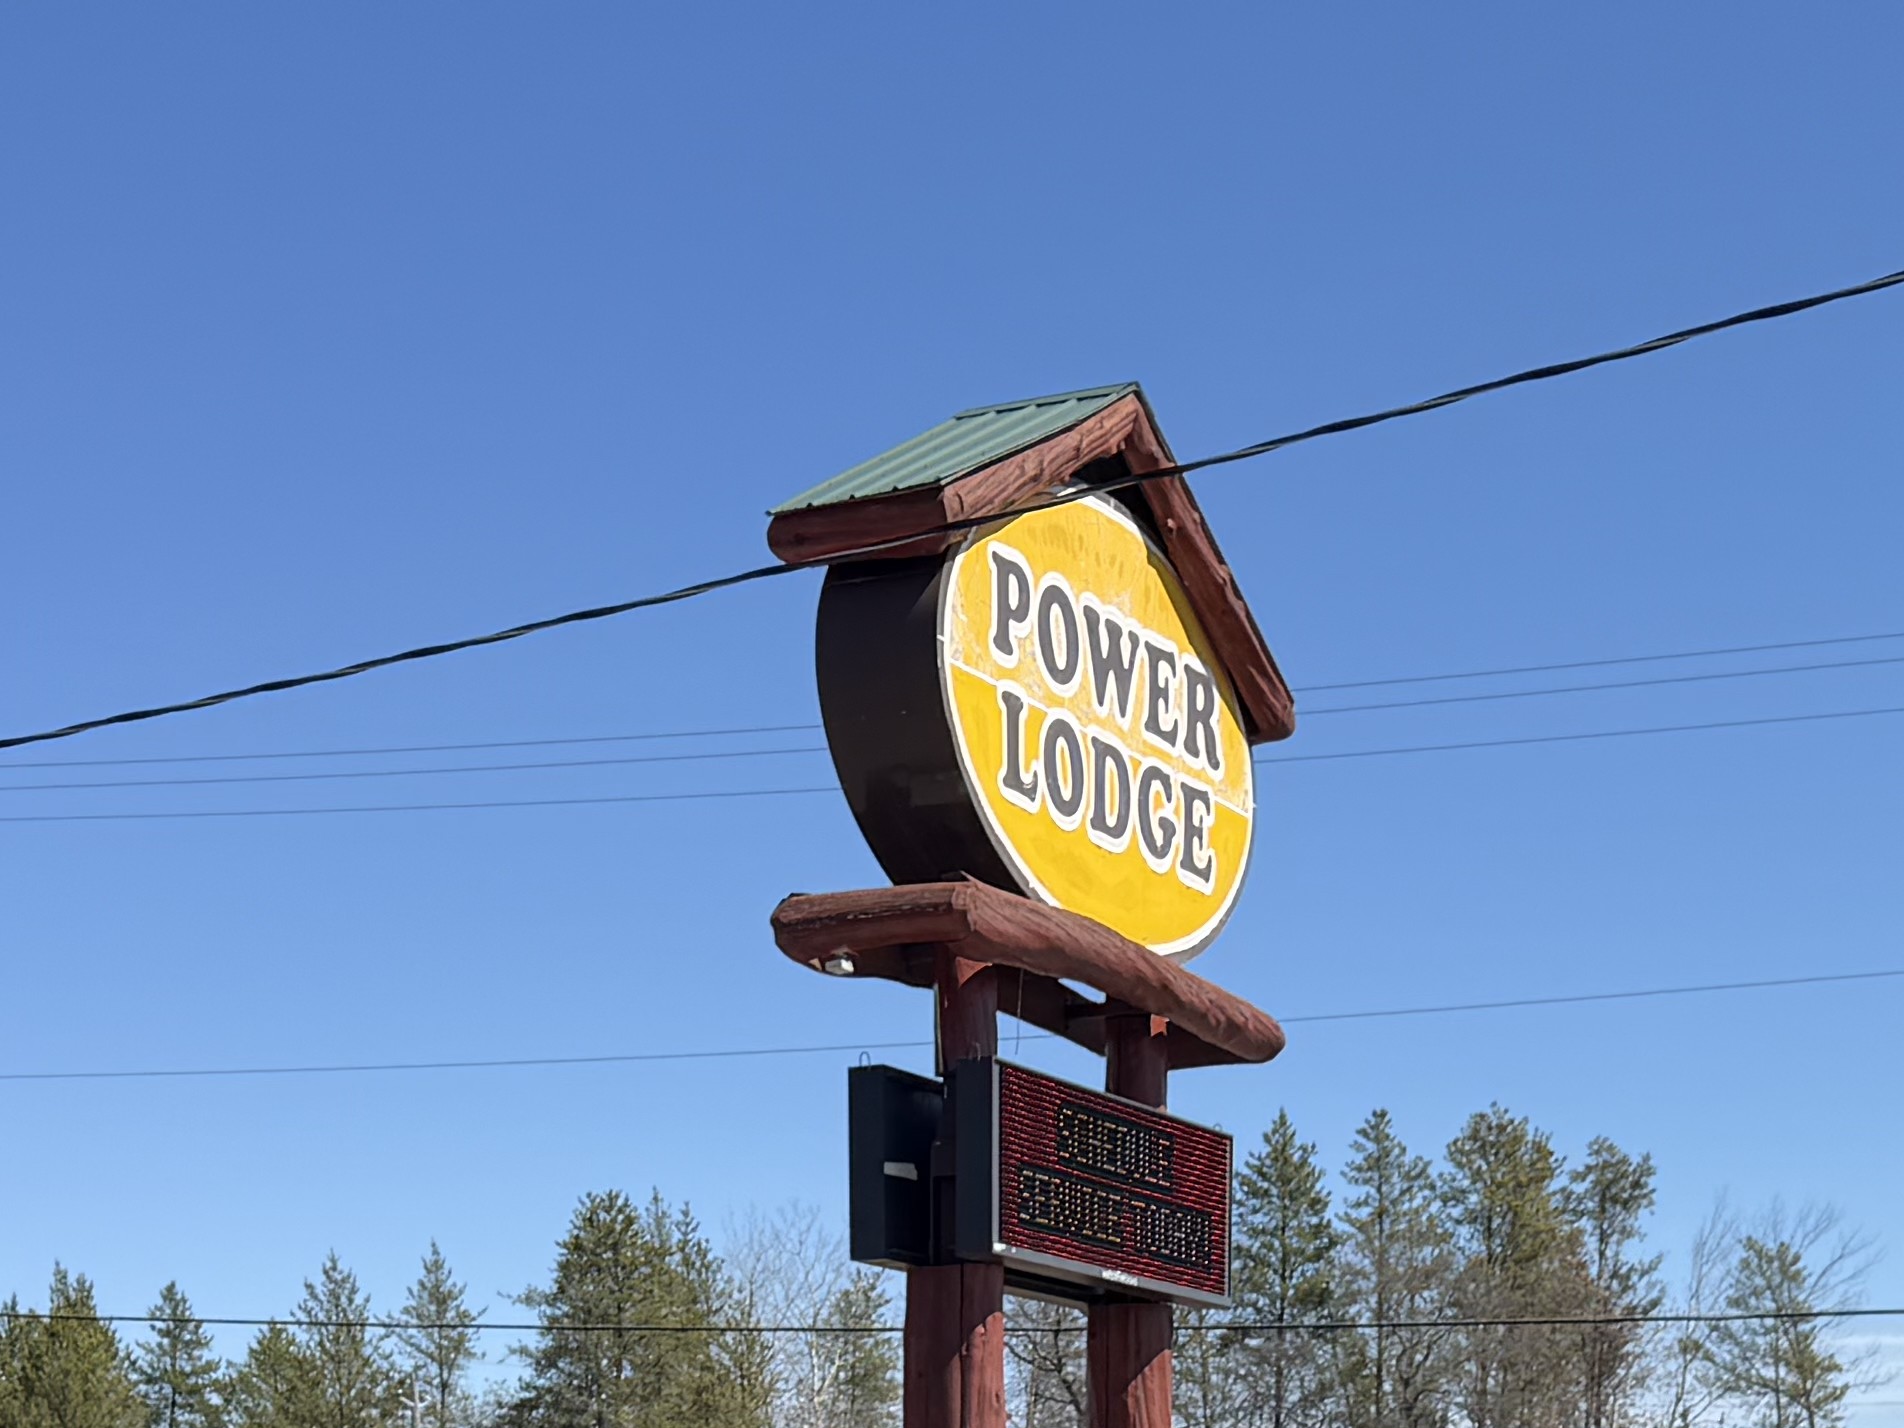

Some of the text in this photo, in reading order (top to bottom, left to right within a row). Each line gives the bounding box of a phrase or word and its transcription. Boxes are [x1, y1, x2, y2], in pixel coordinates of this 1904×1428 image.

[990, 549, 1222, 772] POWER
[999, 689, 1215, 885] LODGE
[1019, 1169, 1122, 1243] SERVICE
[1059, 1108, 1171, 1188] SCHEDULE
